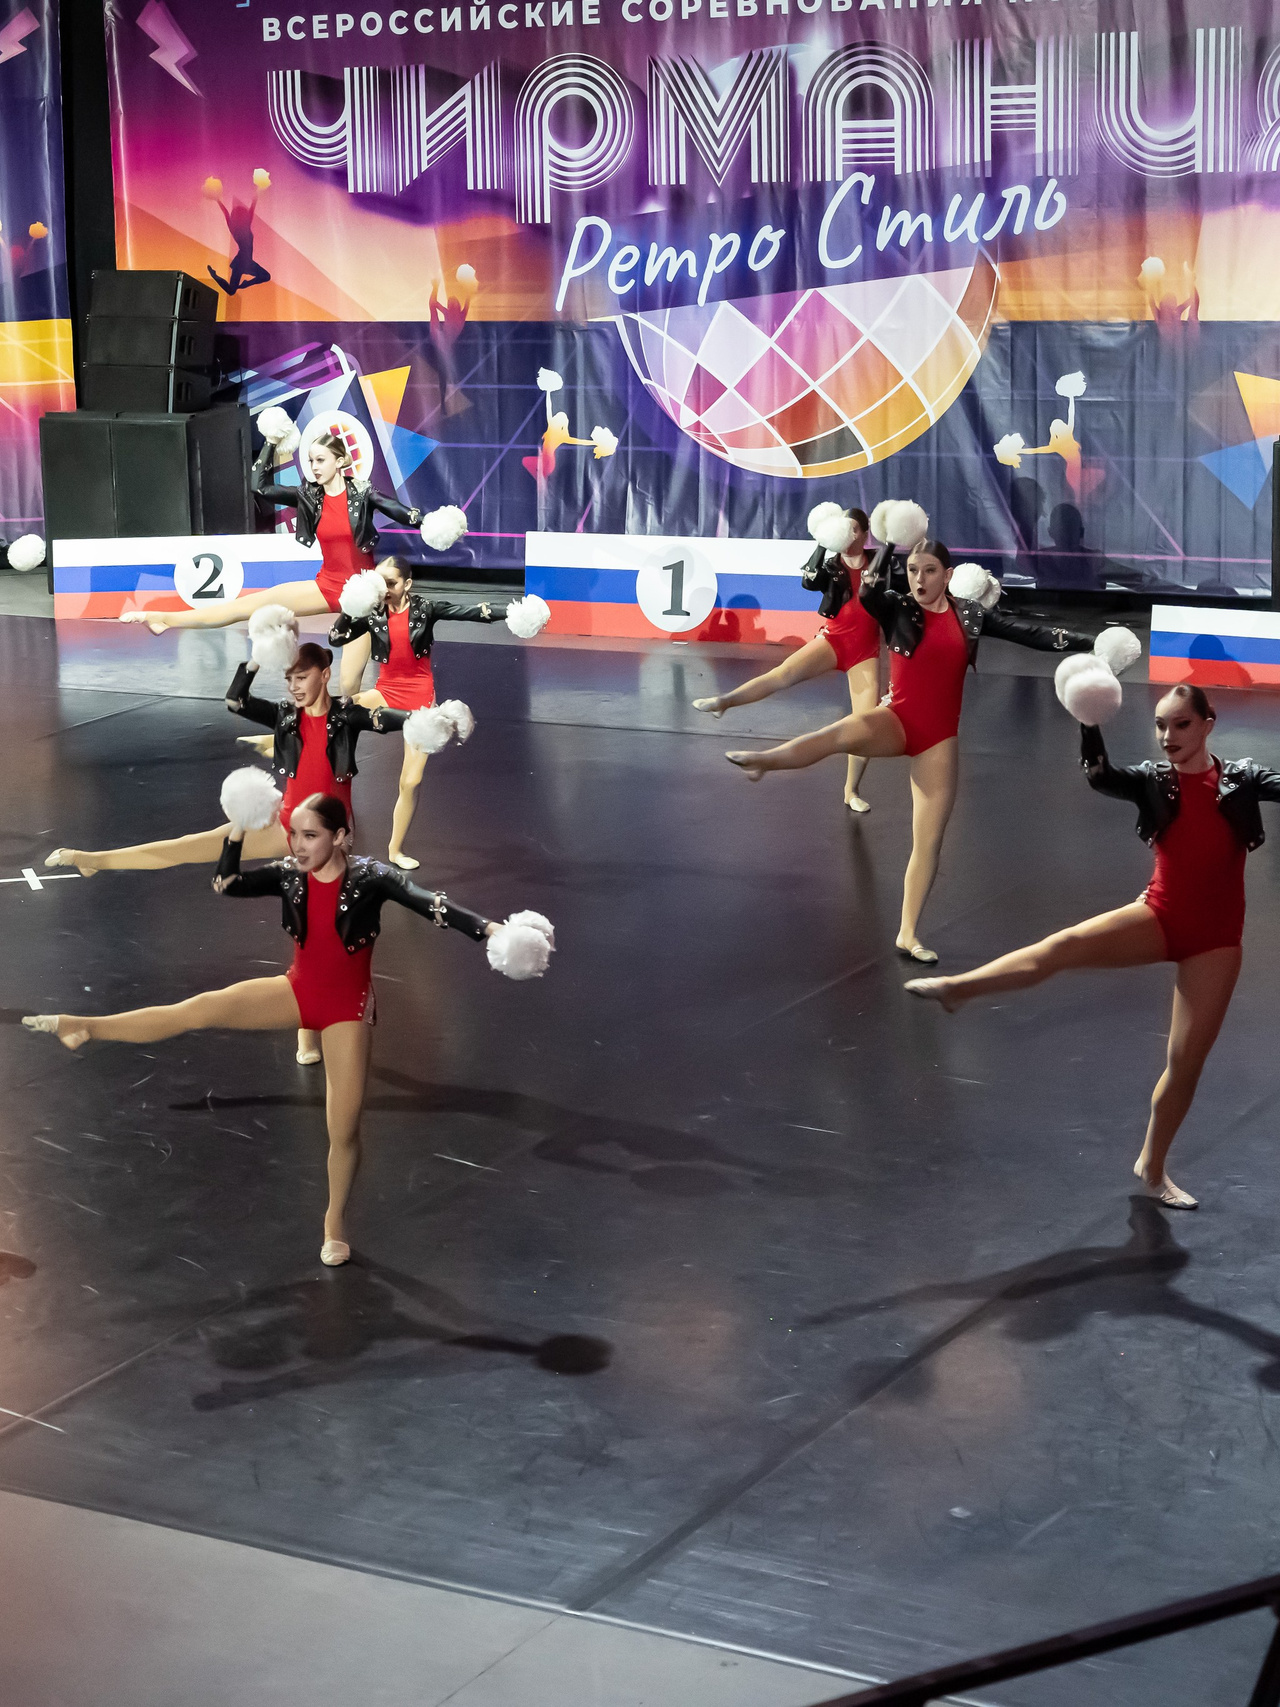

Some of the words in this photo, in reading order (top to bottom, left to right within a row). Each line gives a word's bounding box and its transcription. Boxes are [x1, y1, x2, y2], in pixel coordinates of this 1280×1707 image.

[262, 0, 601, 42] ВСЕРОССИЙСКИЕ
[555, 215, 786, 312] Ретро
[817, 172, 1068, 268] Стиль
[192, 553, 225, 599] 2
[662, 560, 691, 616] 1
